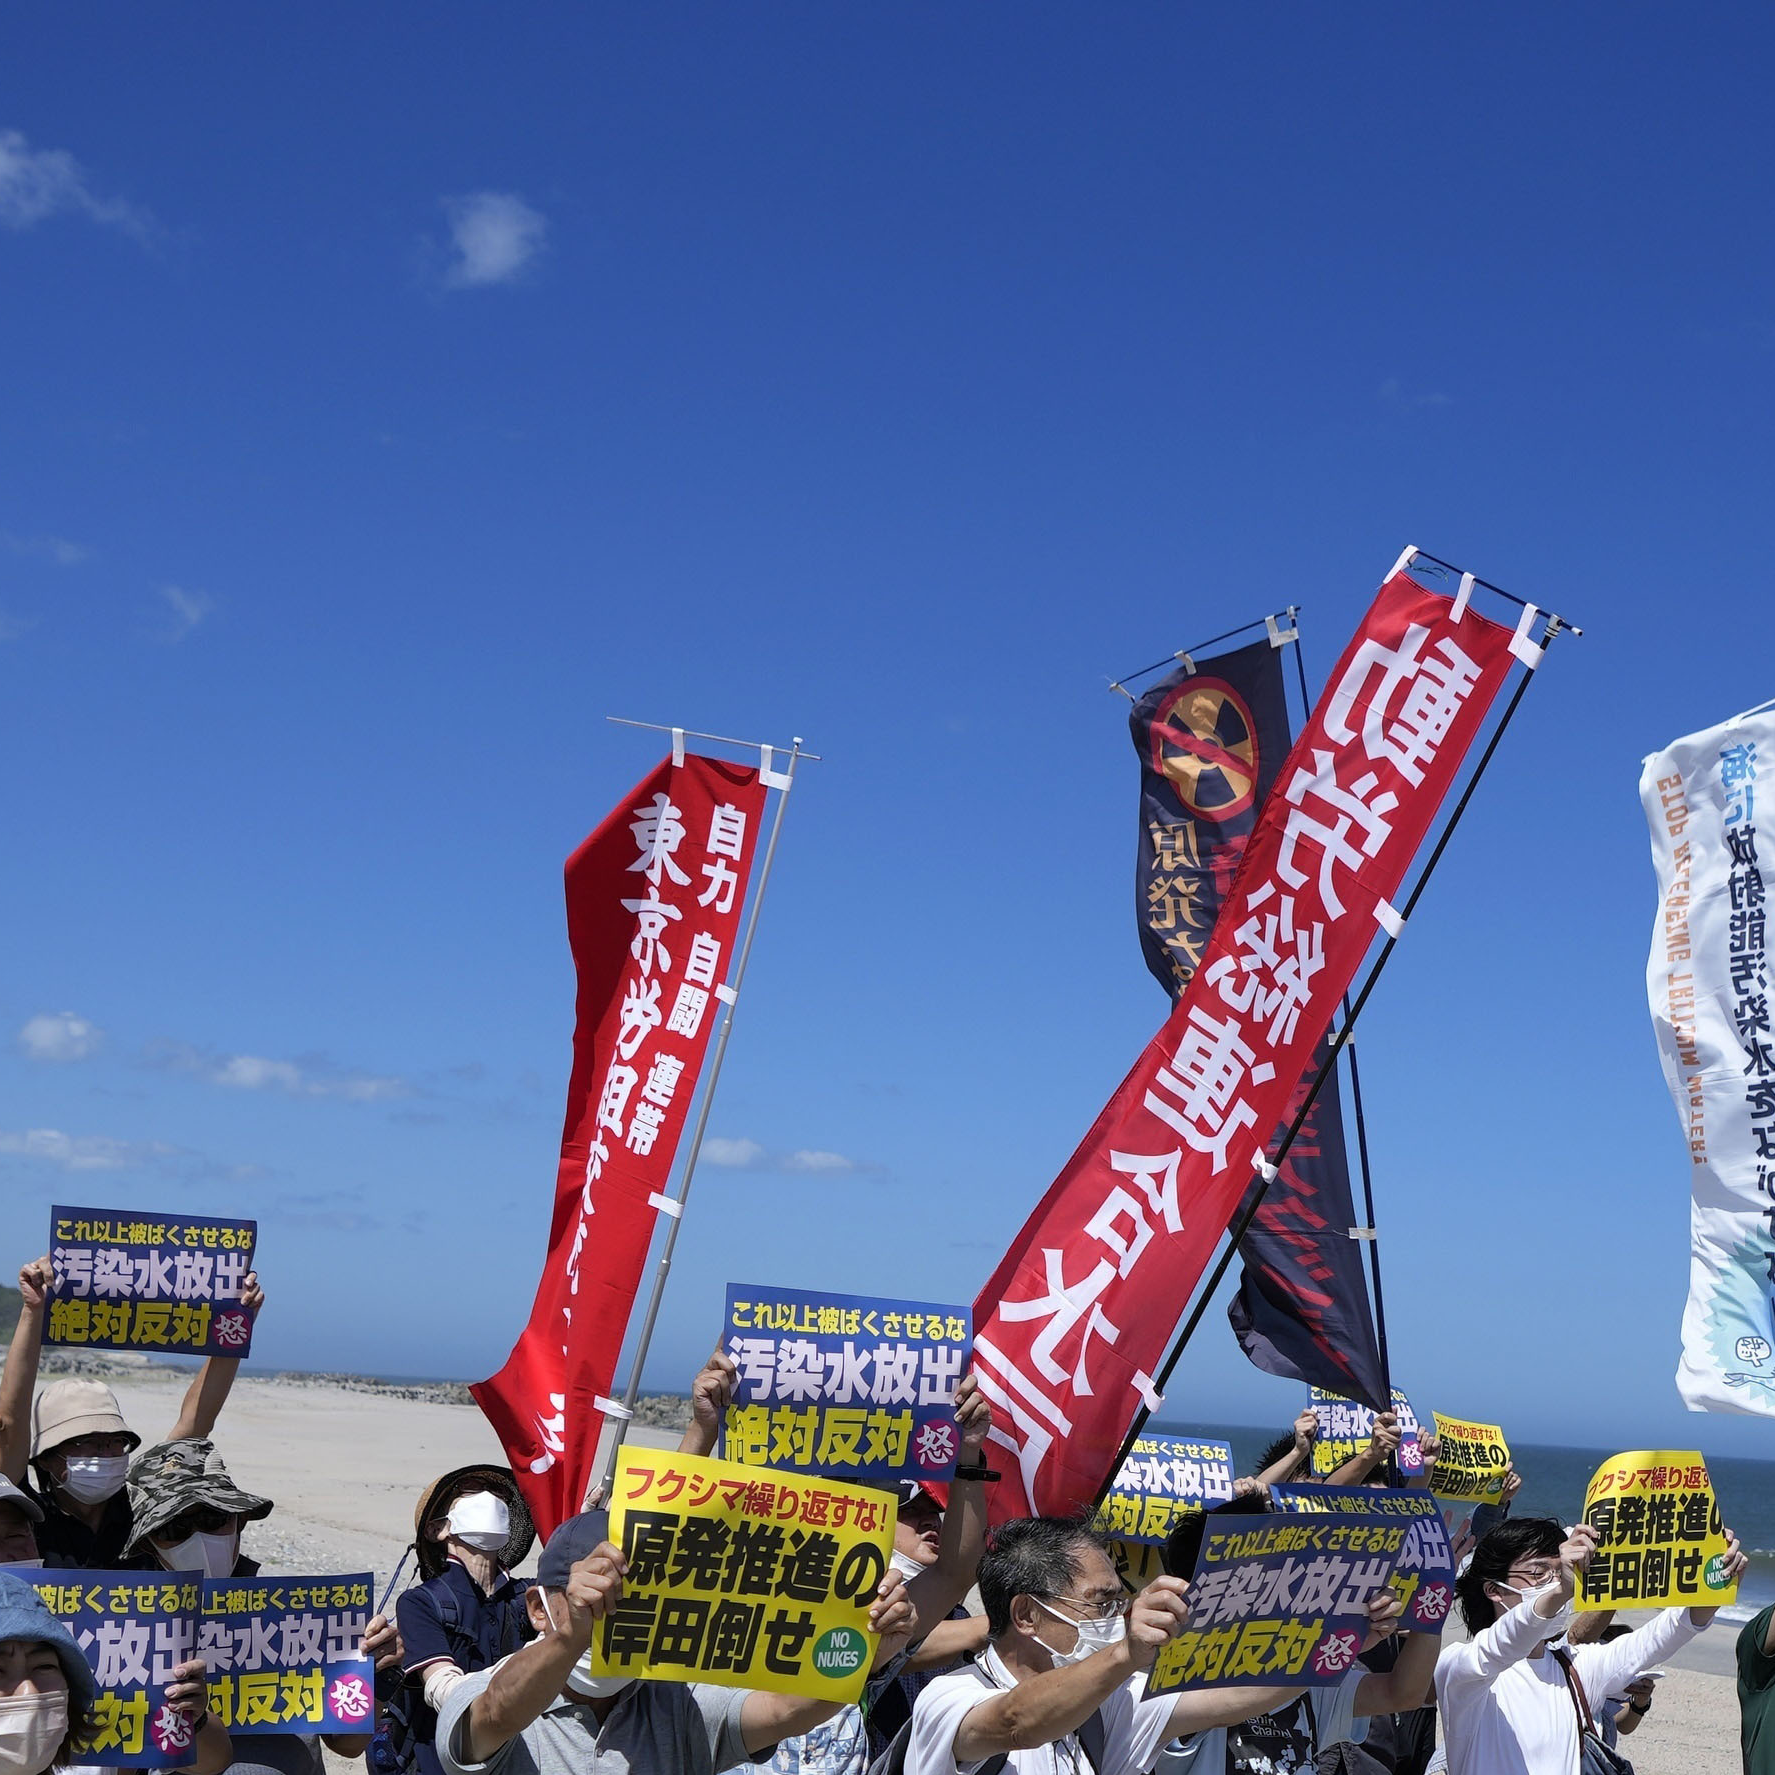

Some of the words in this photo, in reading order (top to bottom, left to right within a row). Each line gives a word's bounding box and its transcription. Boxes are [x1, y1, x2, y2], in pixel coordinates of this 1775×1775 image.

[697, 803, 747, 914] 自力
[625, 1051, 685, 1158] 連帯
[56, 1220, 252, 1249] これ以上被ばくさせるな
[52, 1247, 249, 1300] 汚染水放出
[49, 1298, 212, 1346] 絶対反対
[215, 1314, 248, 1345] 怒
[730, 1301, 966, 1342] これ以上被ばくさせるな
[726, 1334, 963, 1407] 汚染水放出
[724, 1404, 913, 1469] 絶対反対
[915, 1424, 956, 1464] 怒
[1401, 1443, 1422, 1467] 怒
[625, 1467, 887, 1532] フクシマ繰り返すな!
[1113, 1456, 1233, 1501] 染水放出
[621, 1508, 884, 1609] 原発推進の
[1205, 1525, 1405, 1562] これ以上被ばくさせるな
[1187, 1556, 1390, 1629] 汚染水放出
[1581, 1548, 1703, 1603] 岸田倒せ
[201, 1583, 369, 1615] 上被ばくさせるな
[1416, 1586, 1448, 1620] 怒
[603, 1597, 815, 1676] 岸田倒せ
[817, 1649, 859, 1668] NUKES
[829, 1631, 850, 1649] NO
[1149, 1619, 1325, 1692] 絶対反対
[1315, 1633, 1356, 1672] 怒
[330, 1679, 369, 1719] 怒
